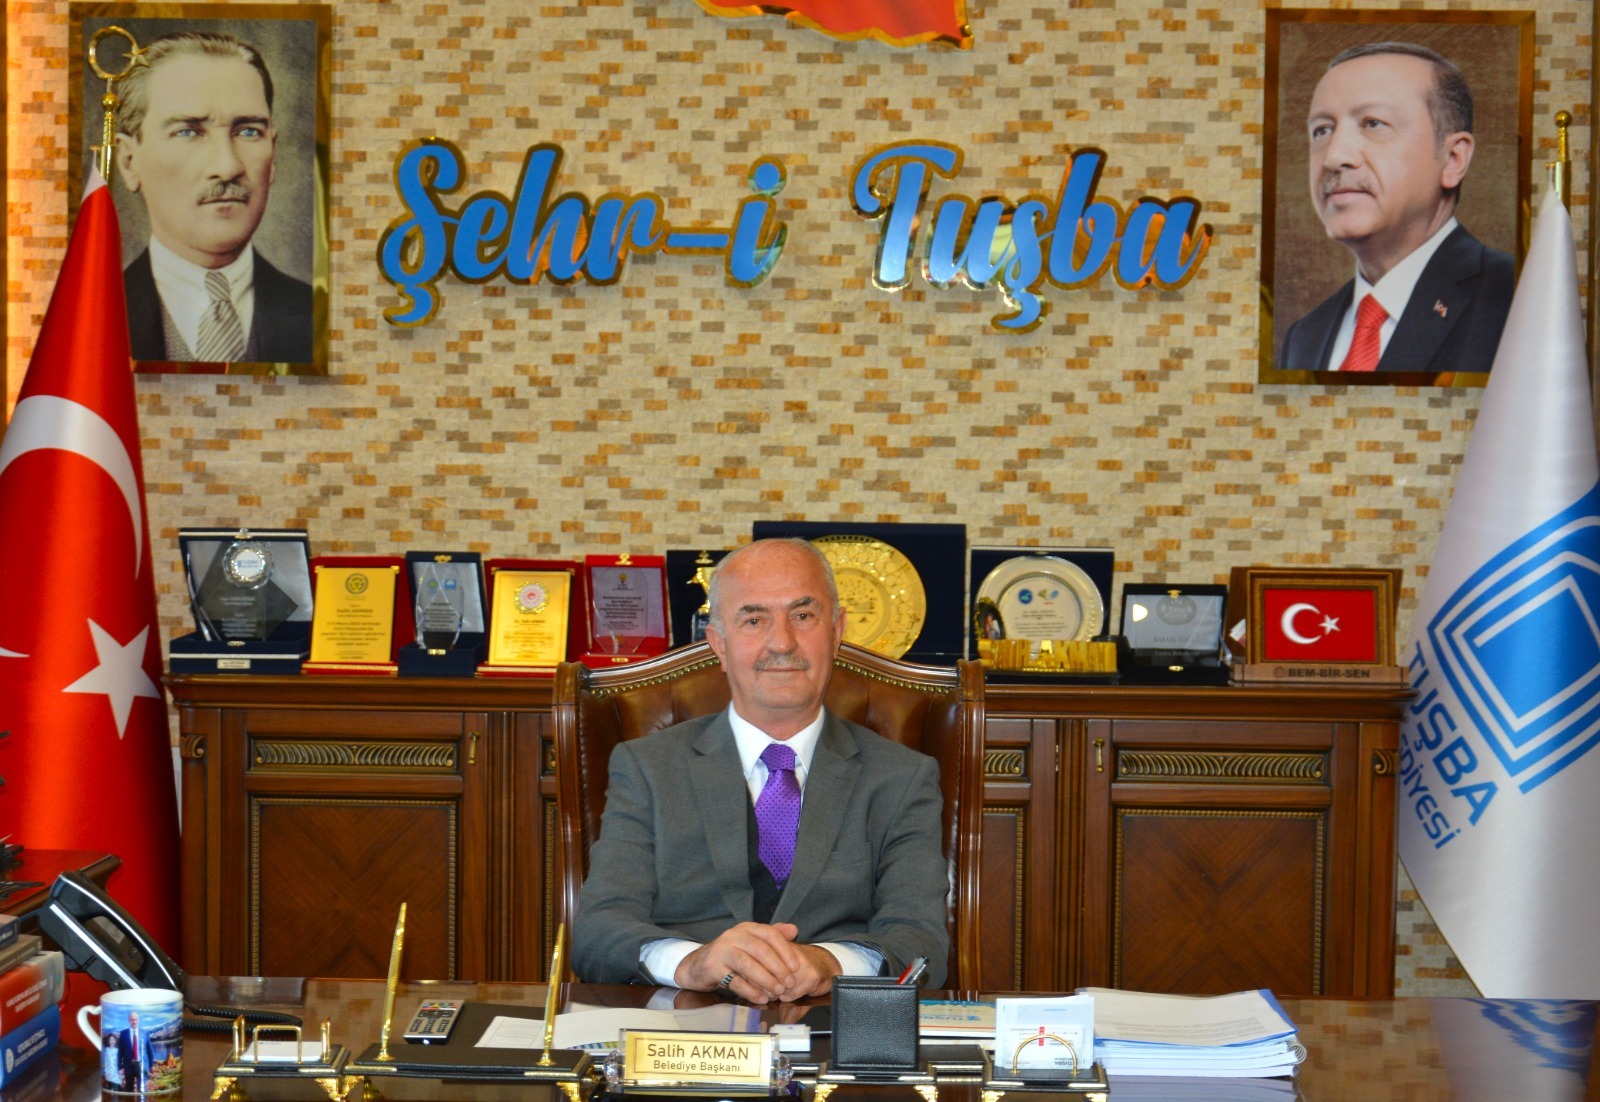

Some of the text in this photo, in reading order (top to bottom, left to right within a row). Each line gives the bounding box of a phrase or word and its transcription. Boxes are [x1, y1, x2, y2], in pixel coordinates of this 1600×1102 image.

[377, 136, 1213, 335] Şehr-i Tuşba
[1288, 667, 1371, 679] BEM-BİR-SEN
[647, 1043, 749, 1060] Salih AKMAN
[653, 1060, 741, 1074] Belediye Başkanı
